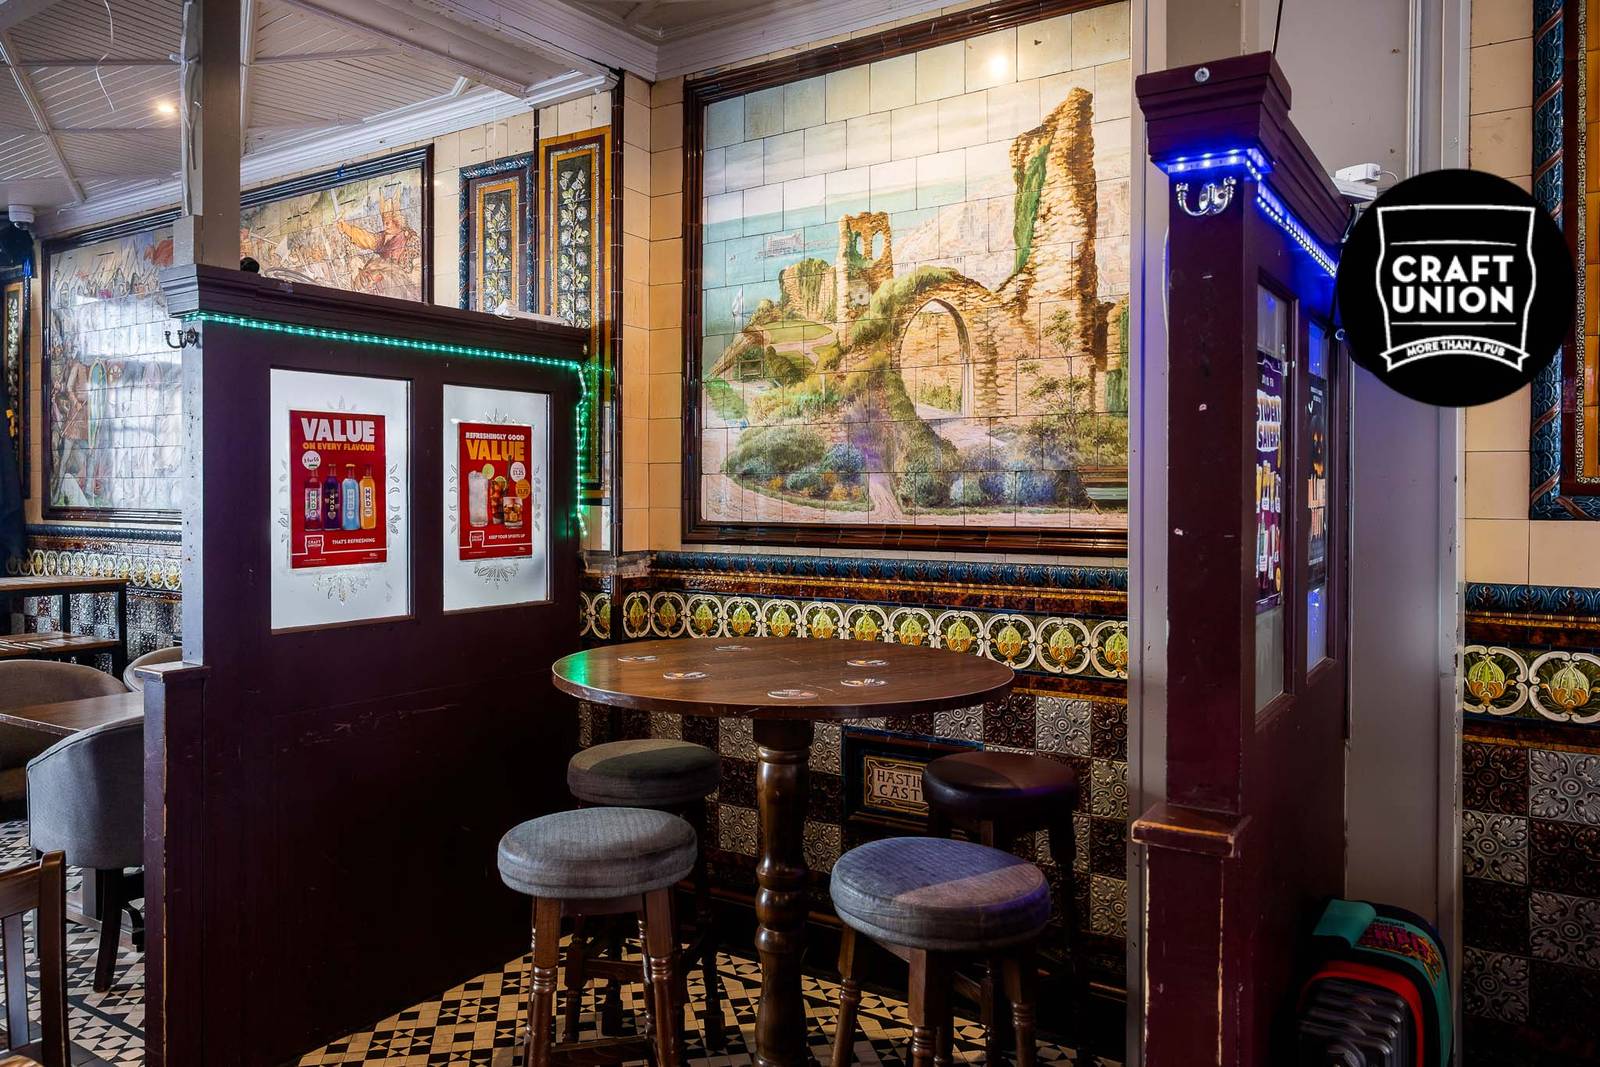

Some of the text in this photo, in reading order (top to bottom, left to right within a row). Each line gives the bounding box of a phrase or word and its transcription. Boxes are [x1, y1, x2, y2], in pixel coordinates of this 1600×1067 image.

[301, 417, 375, 443] VALUE
[465, 431, 507, 440] REFRESHINGLY
[302, 442, 376, 452] ON EVERY FLAVOUR
[465, 439, 525, 462] VALUE
[879, 784, 920, 801] CAST
